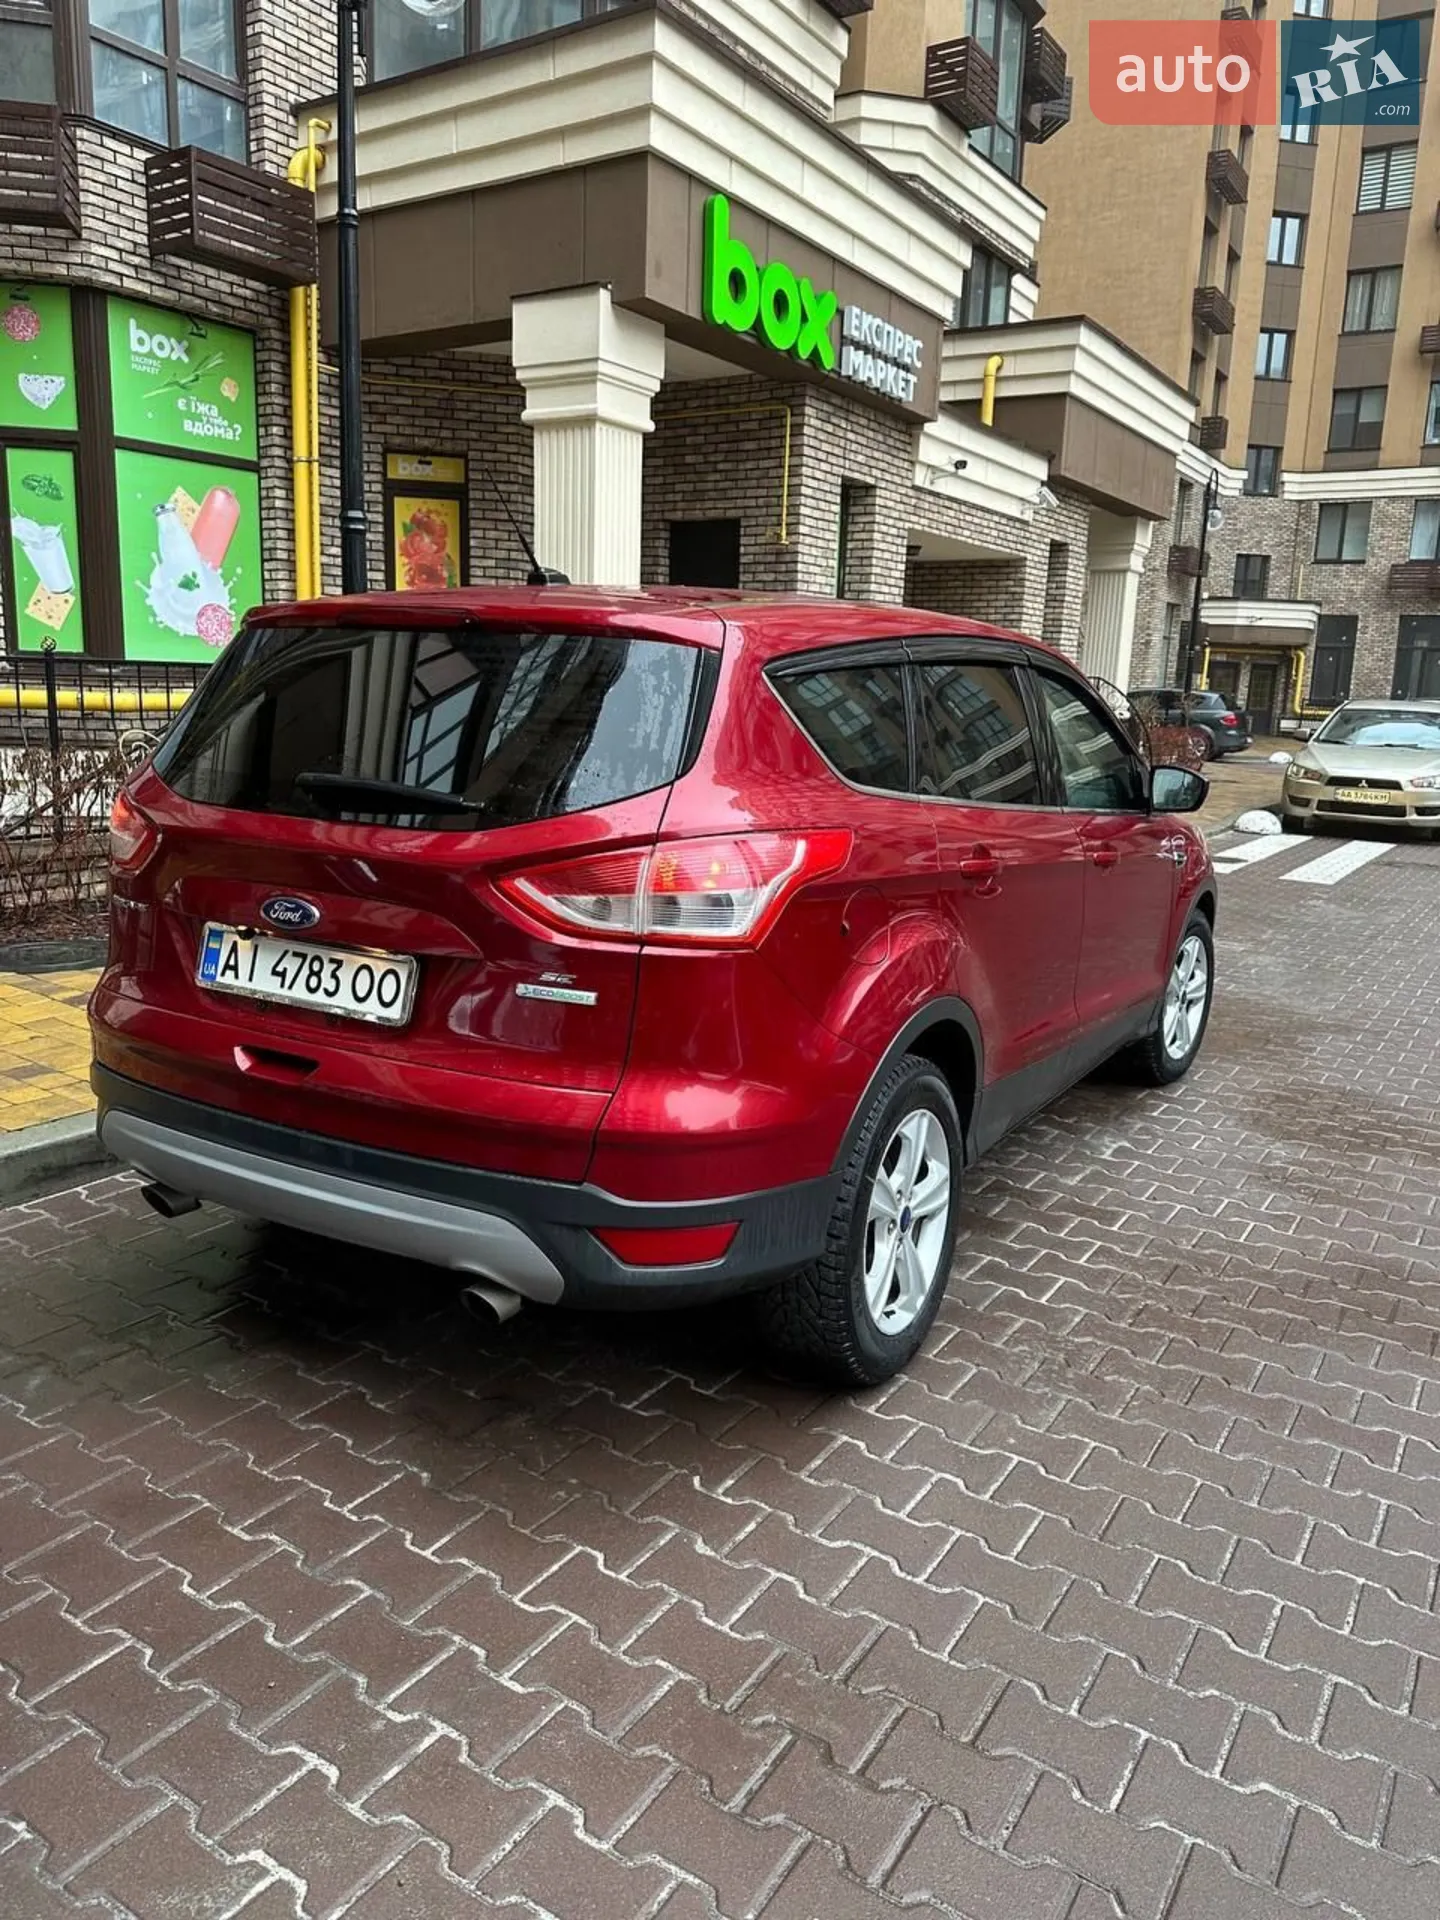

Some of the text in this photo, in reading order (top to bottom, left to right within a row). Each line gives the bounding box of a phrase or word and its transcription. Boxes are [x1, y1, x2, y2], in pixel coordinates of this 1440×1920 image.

[703, 193, 838, 370] box
[129, 318, 190, 363] box
[842, 305, 923, 368] ЕКСПРЕС
[841, 345, 918, 402] МАРКЕТ
[190, 396, 218, 418] їжа
[183, 420, 242, 441] вдома?
[269, 901, 303, 923] Ford
[204, 963, 216, 975] UA
[220, 940, 258, 982] AI
[271, 949, 344, 998] 4783
[540, 971, 577, 984] SE
